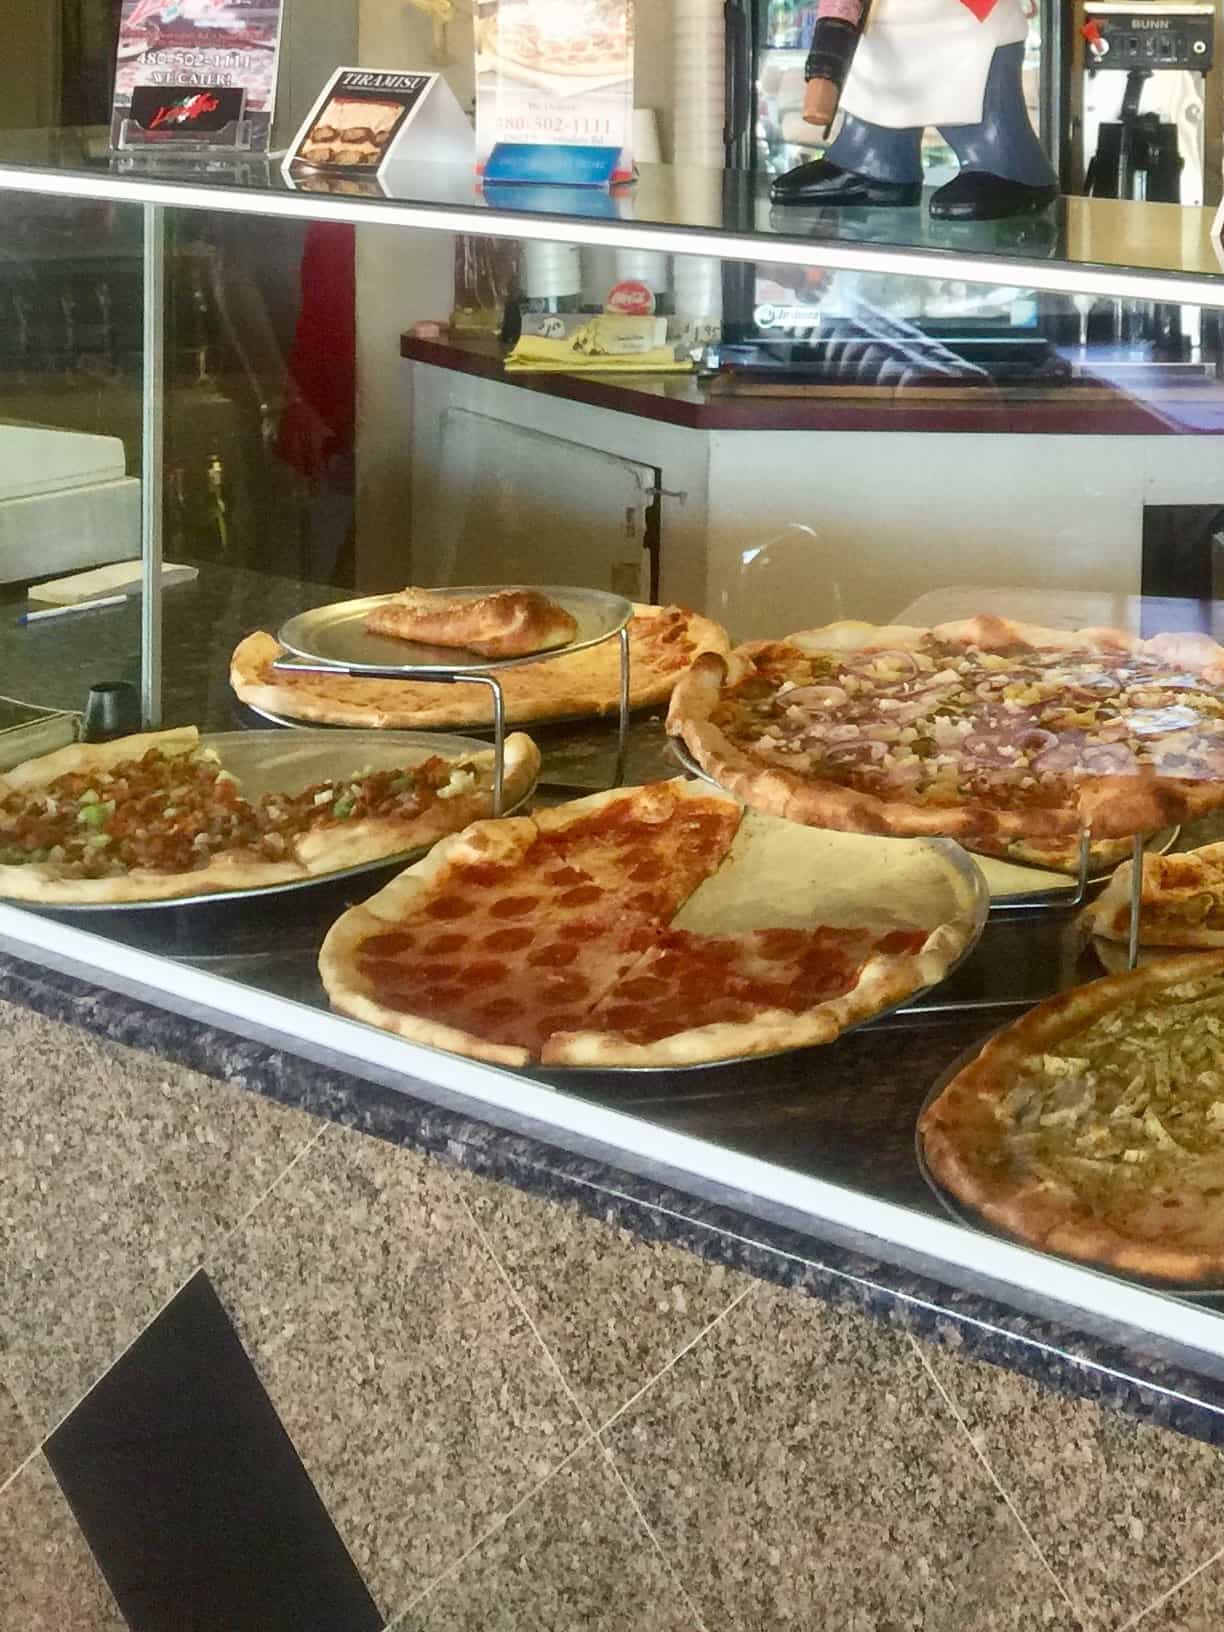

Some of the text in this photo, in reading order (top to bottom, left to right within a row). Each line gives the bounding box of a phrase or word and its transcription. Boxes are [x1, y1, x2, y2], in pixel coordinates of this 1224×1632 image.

[1131, 18, 1169, 29] BUNN
[137, 51, 251, 68] 480-502-1111
[342, 72, 425, 90] TIRAMISU
